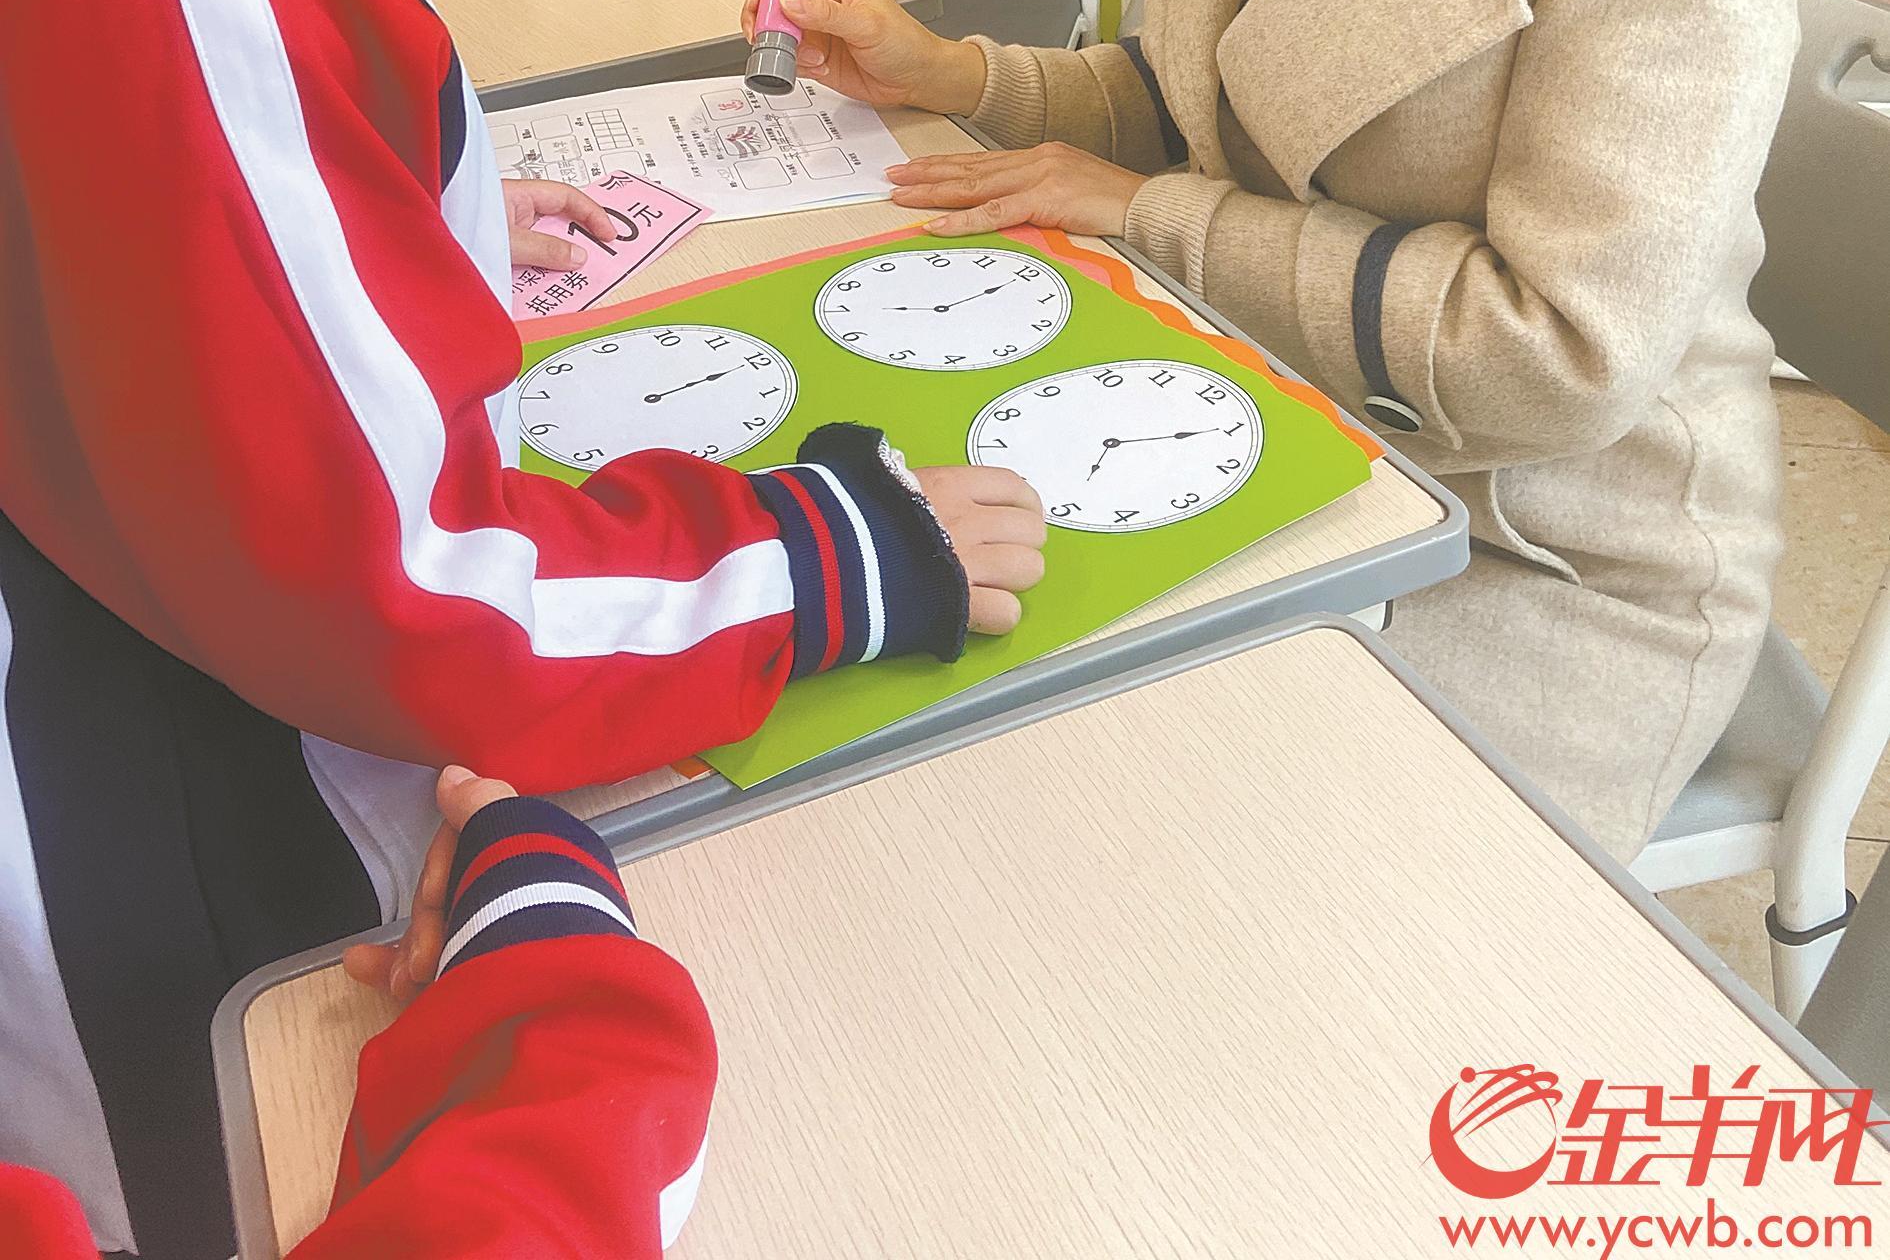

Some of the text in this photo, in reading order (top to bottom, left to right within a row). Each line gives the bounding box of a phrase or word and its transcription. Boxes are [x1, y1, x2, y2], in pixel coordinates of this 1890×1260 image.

[872, 262, 896, 273] 9
[923, 253, 950, 269] 10
[973, 255, 997, 269] 11
[1014, 265, 1040, 282] 12
[837, 280, 861, 292] 8
[525, 271, 589, 316] 抵用券
[1037, 293, 1056, 305] 1
[824, 305, 850, 313] 7
[1031, 319, 1052, 332] 2
[654, 329, 681, 348] 10
[705, 334, 730, 351] 11
[843, 331, 868, 342] 6
[593, 343, 619, 354] 9
[889, 349, 916, 361] 5
[993, 345, 1018, 357] 3
[744, 351, 771, 370] 12
[944, 354, 967, 365] 4
[546, 363, 573, 376] 8
[1093, 368, 1123, 388] 10
[1149, 369, 1176, 388] 11
[759, 387, 781, 399] 1
[1034, 386, 1061, 399] 9
[1195, 384, 1226, 405] 12
[994, 408, 1021, 421] 8
[530, 423, 559, 436] 6
[743, 417, 766, 431] 2
[1223, 422, 1245, 437] 1
[977, 438, 1008, 449] 7
[573, 447, 604, 462] 5
[1216, 459, 1241, 474] 2
[1171, 493, 1200, 510] 3
[1051, 502, 1082, 517] 5
[1114, 509, 1140, 524] 4
